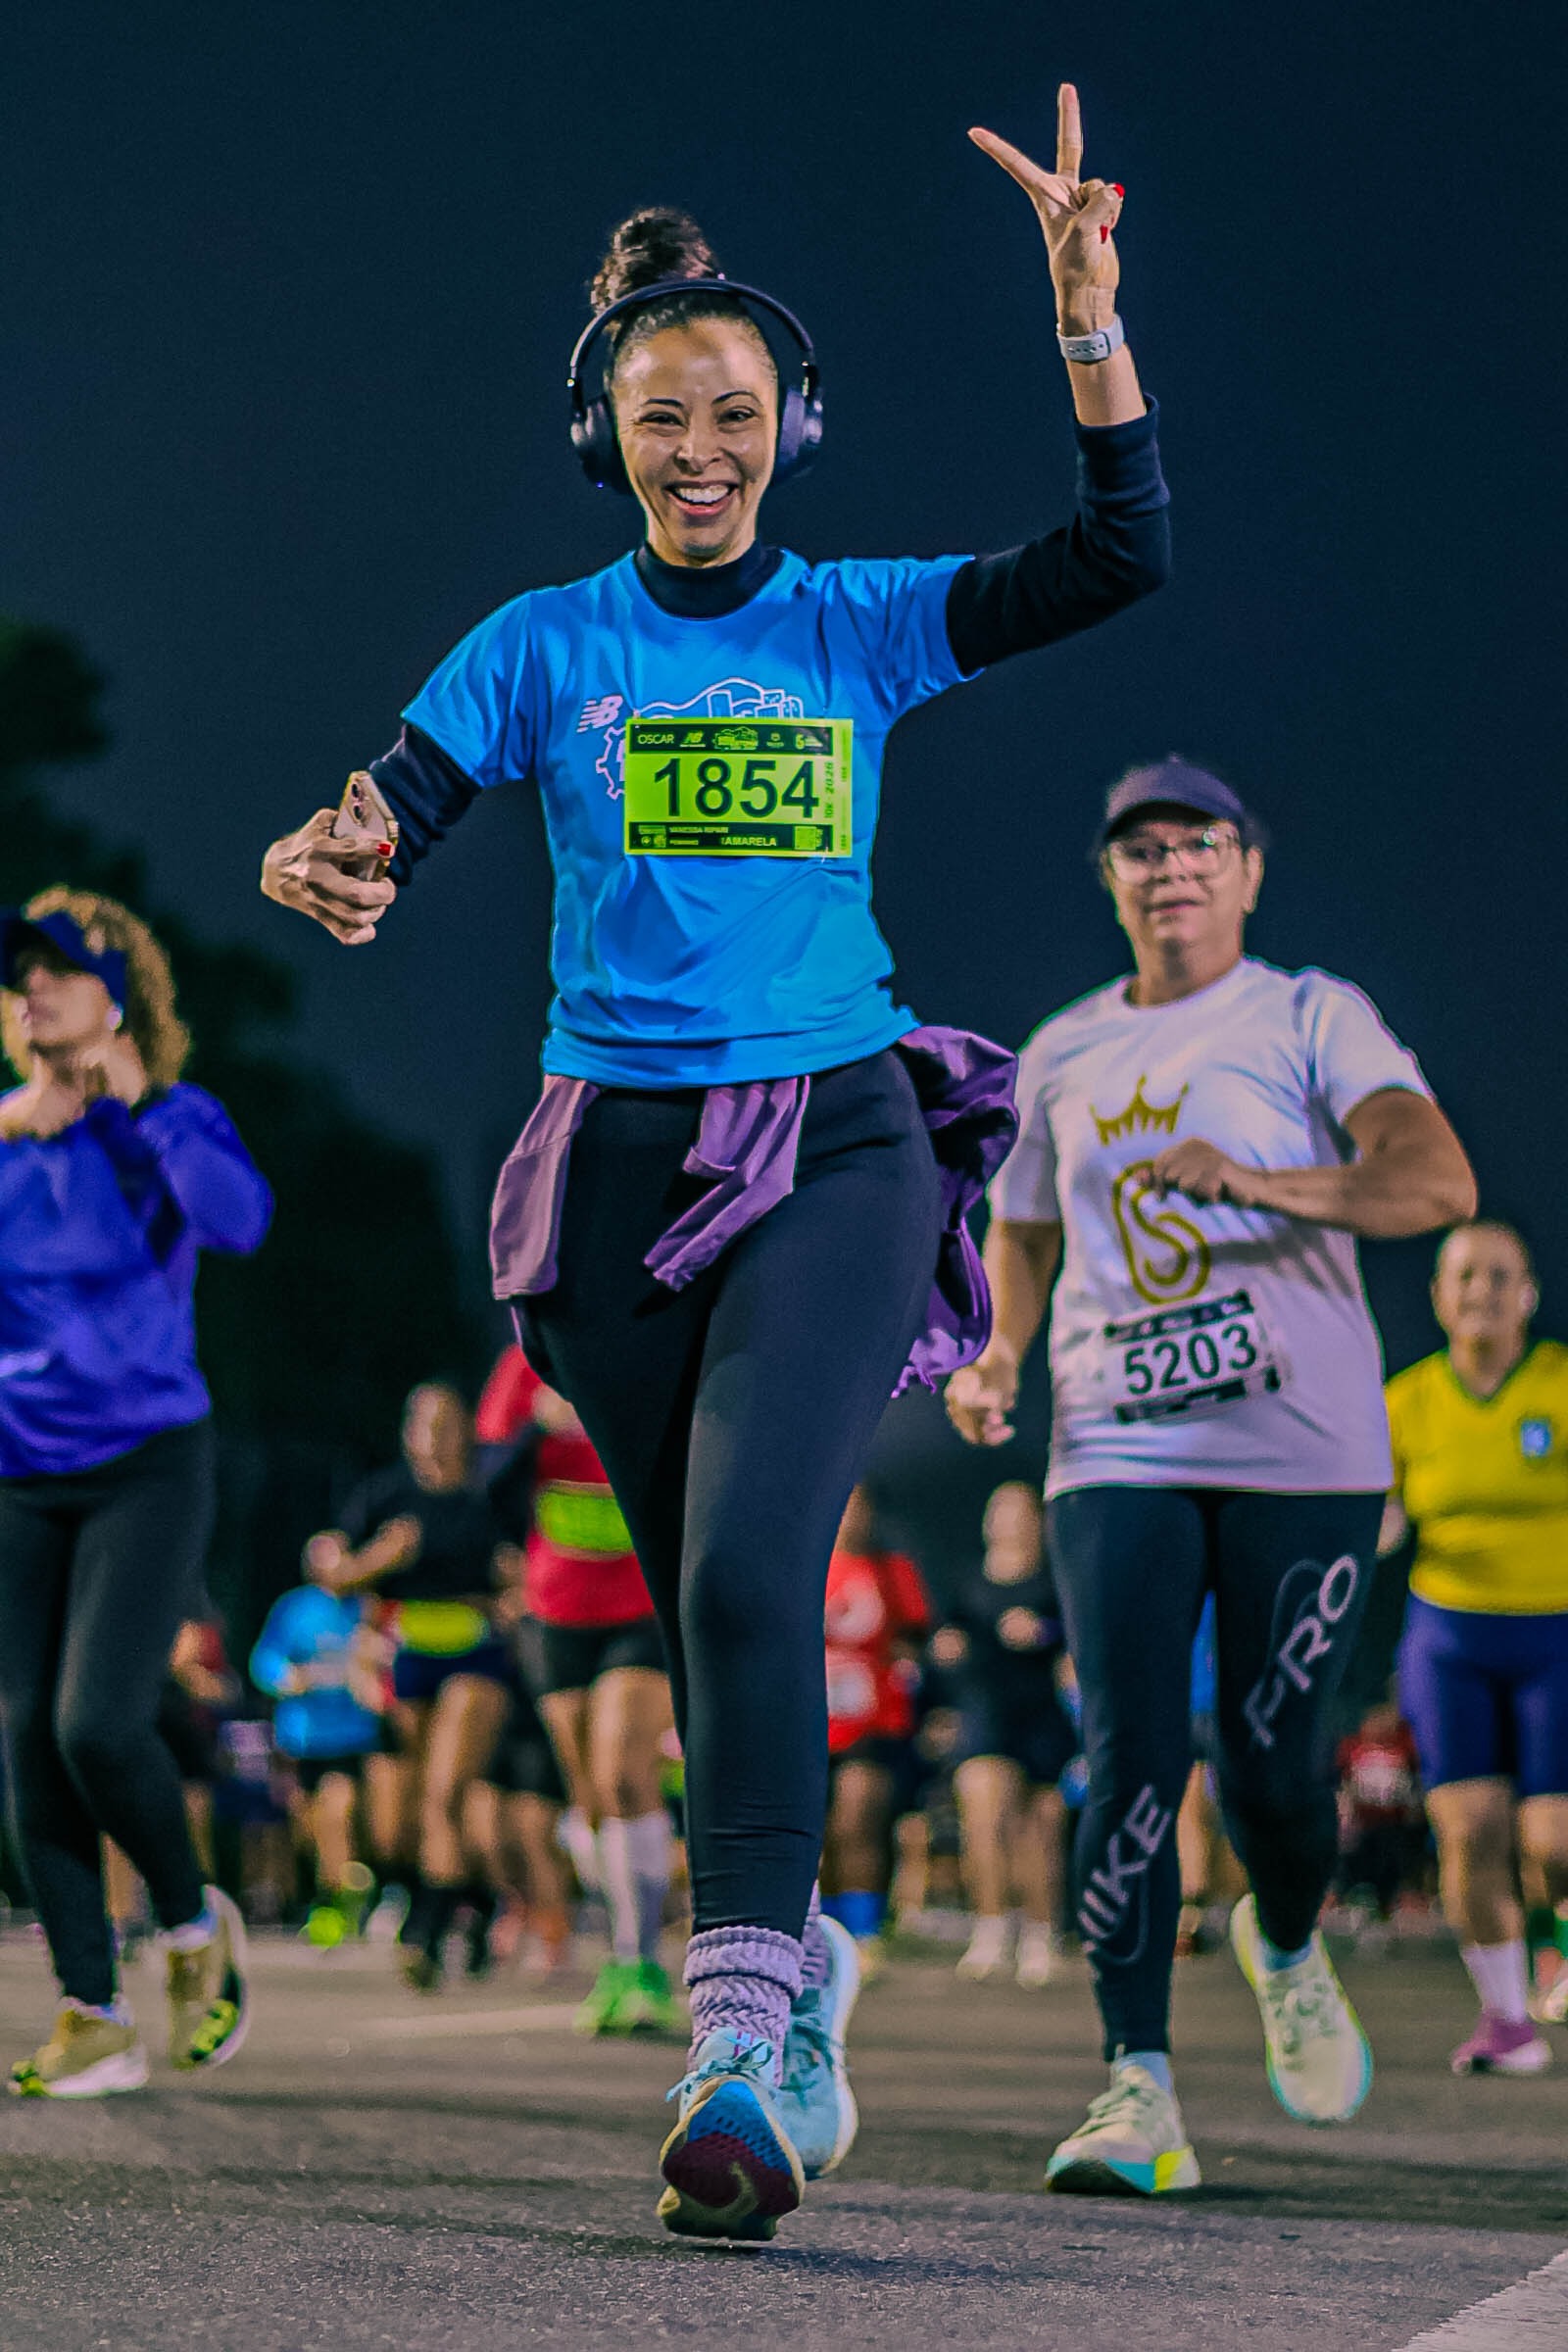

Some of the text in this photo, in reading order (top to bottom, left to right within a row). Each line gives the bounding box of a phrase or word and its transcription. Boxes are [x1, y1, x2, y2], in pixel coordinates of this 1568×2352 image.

[637, 734, 674, 745] OSCAR
[654, 758, 819, 818] 1854
[1124, 1323, 1256, 1396] 5203
